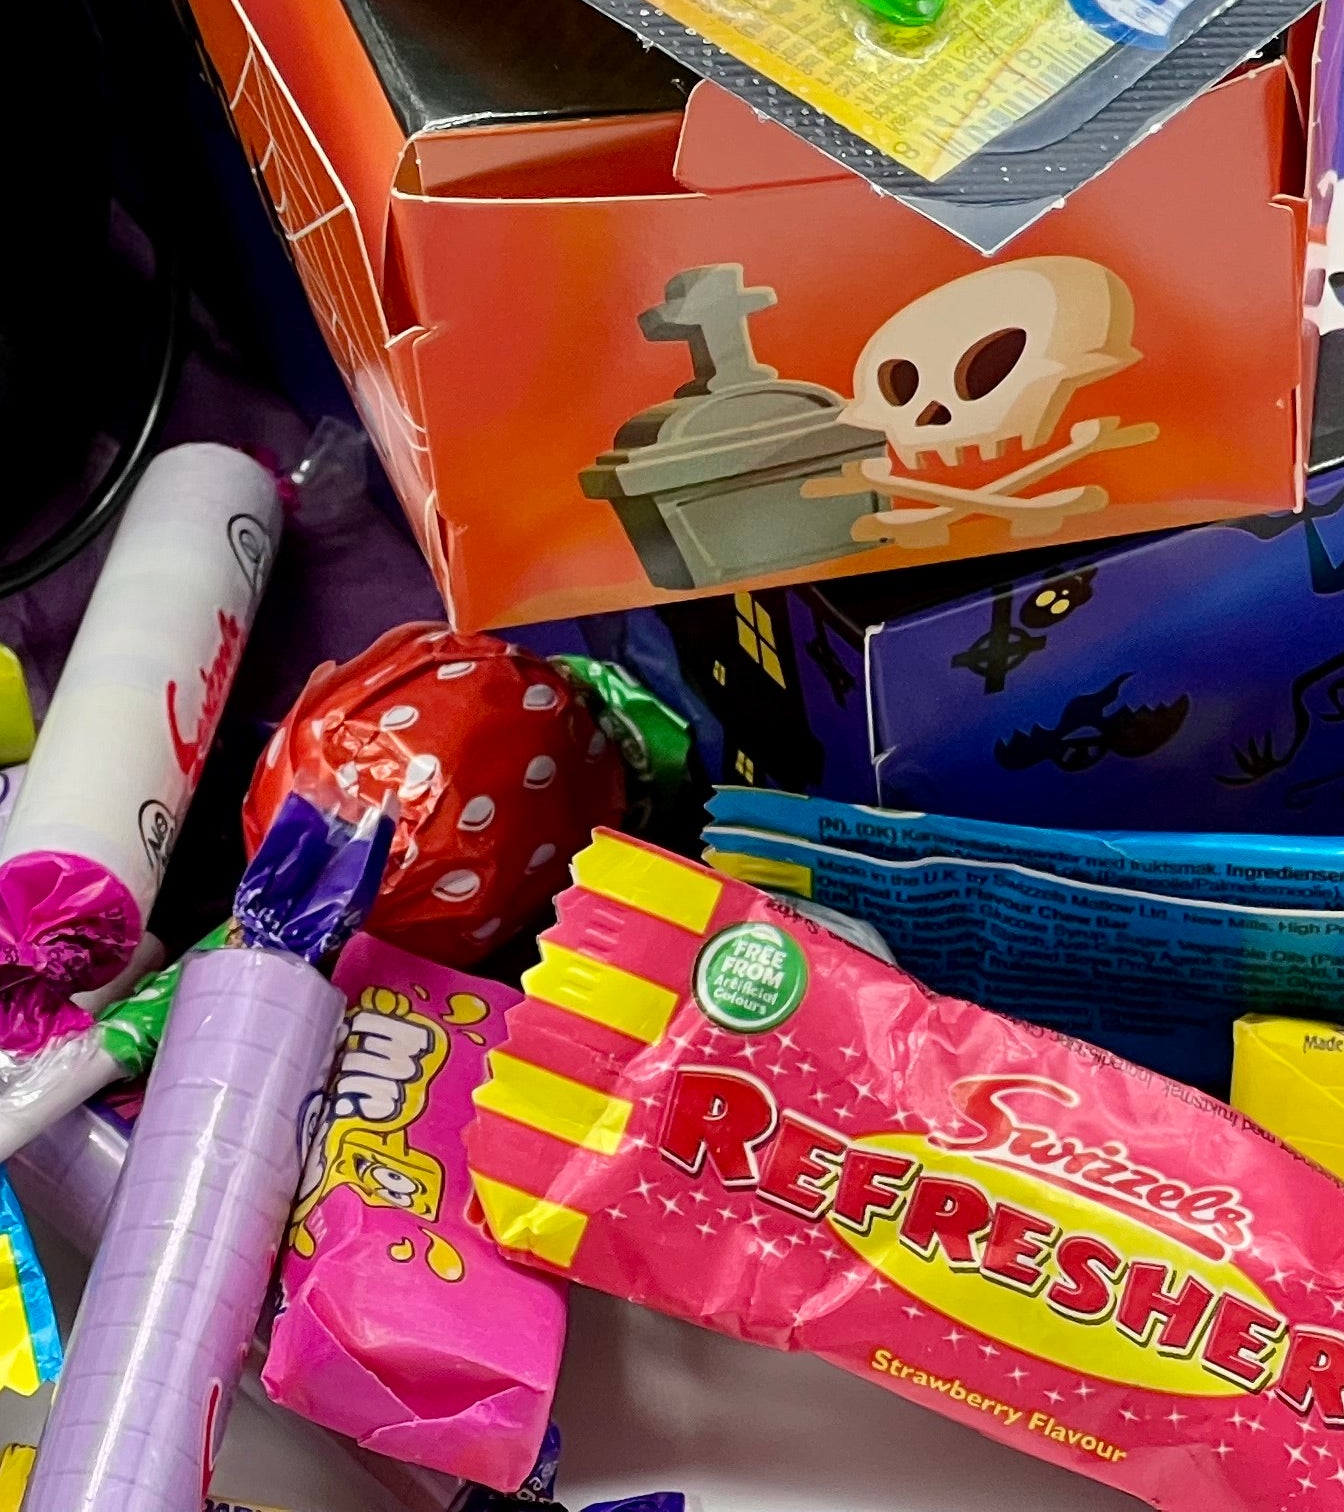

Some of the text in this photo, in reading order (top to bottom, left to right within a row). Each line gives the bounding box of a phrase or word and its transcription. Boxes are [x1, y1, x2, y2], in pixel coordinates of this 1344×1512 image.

[721, 939, 787, 989] FREE FROM
[1304, 1035, 1343, 1054] Made
[928, 1075, 1253, 1260] Swizzels
[872, 1349, 1127, 1462] Strawberry Flavour
